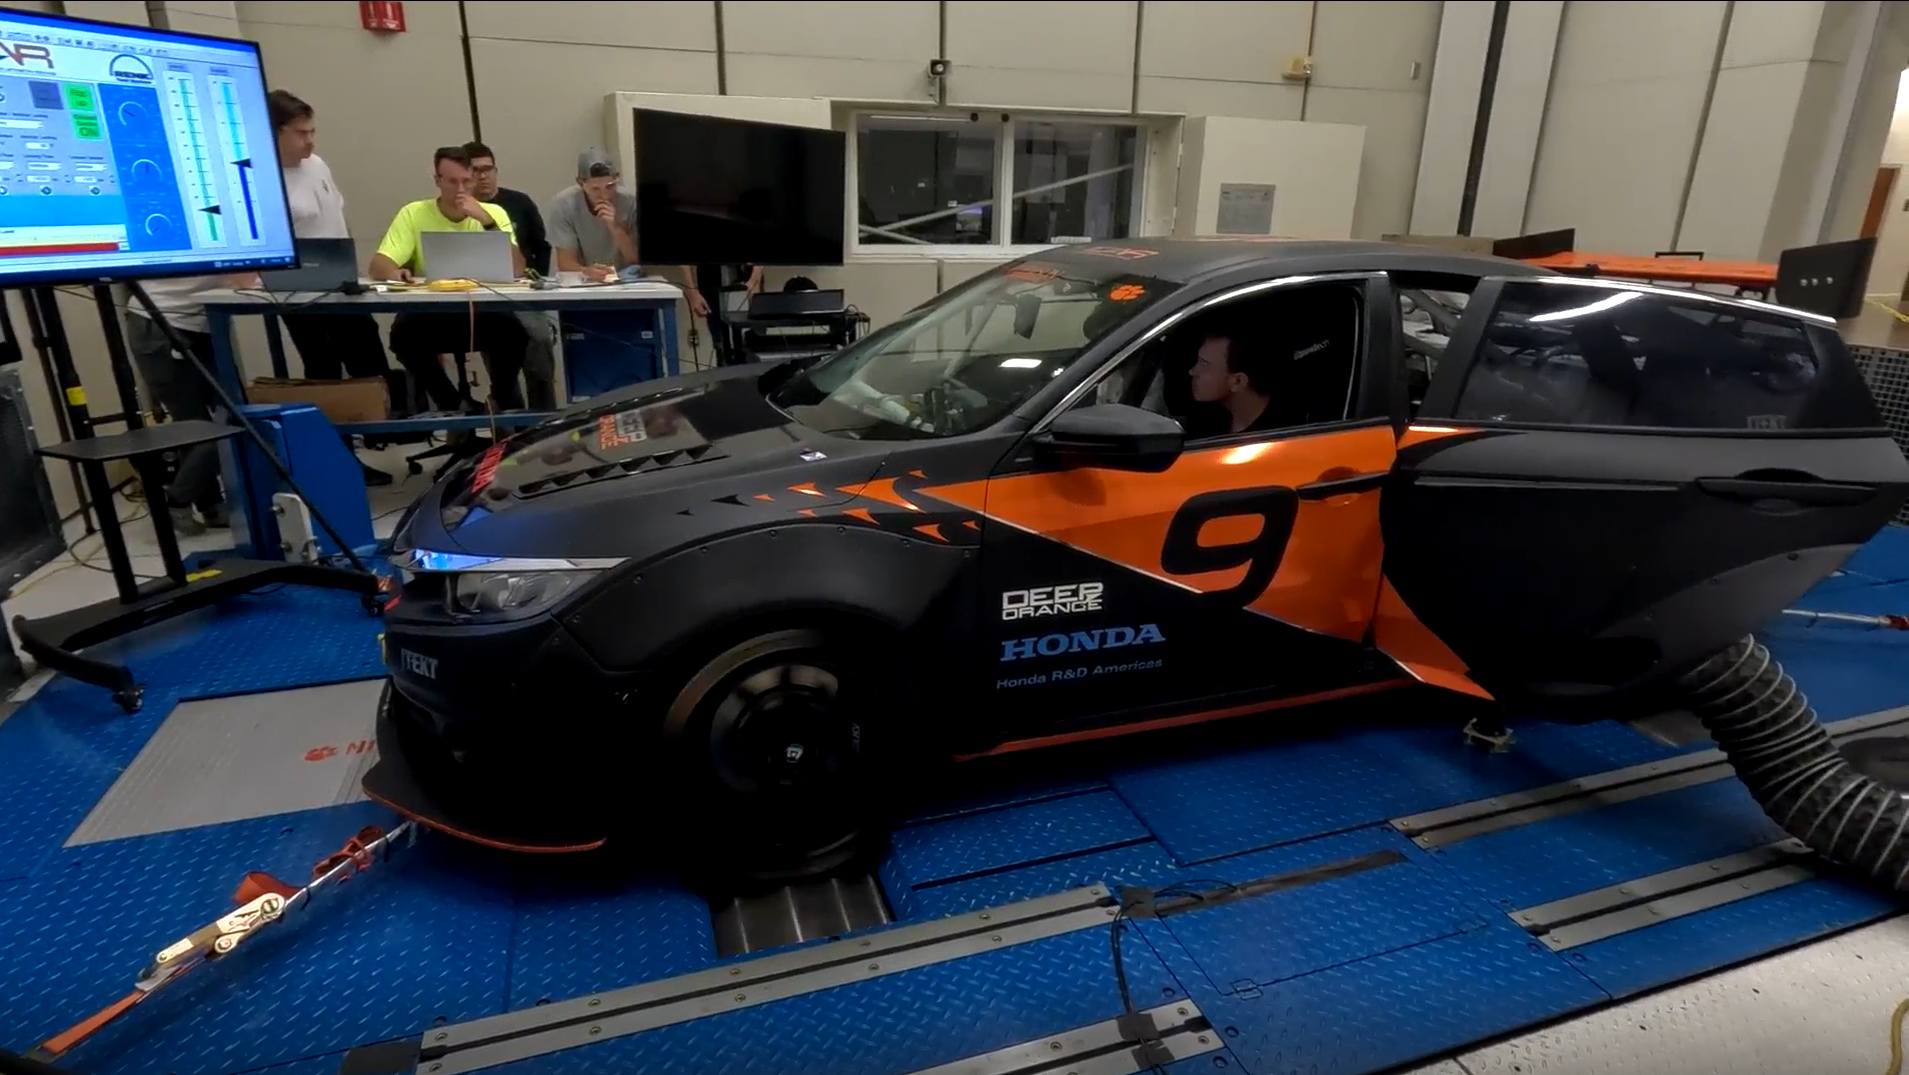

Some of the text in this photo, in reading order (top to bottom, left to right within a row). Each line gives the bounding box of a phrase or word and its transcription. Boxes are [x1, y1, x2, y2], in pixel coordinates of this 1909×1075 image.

[1161, 485, 1299, 608] 9
[1002, 582, 1104, 609] DEEP
[1002, 600, 1103, 620] ORANGE
[1000, 624, 1166, 661] HONDA
[996, 658, 1163, 690] Honda R&D Americas
